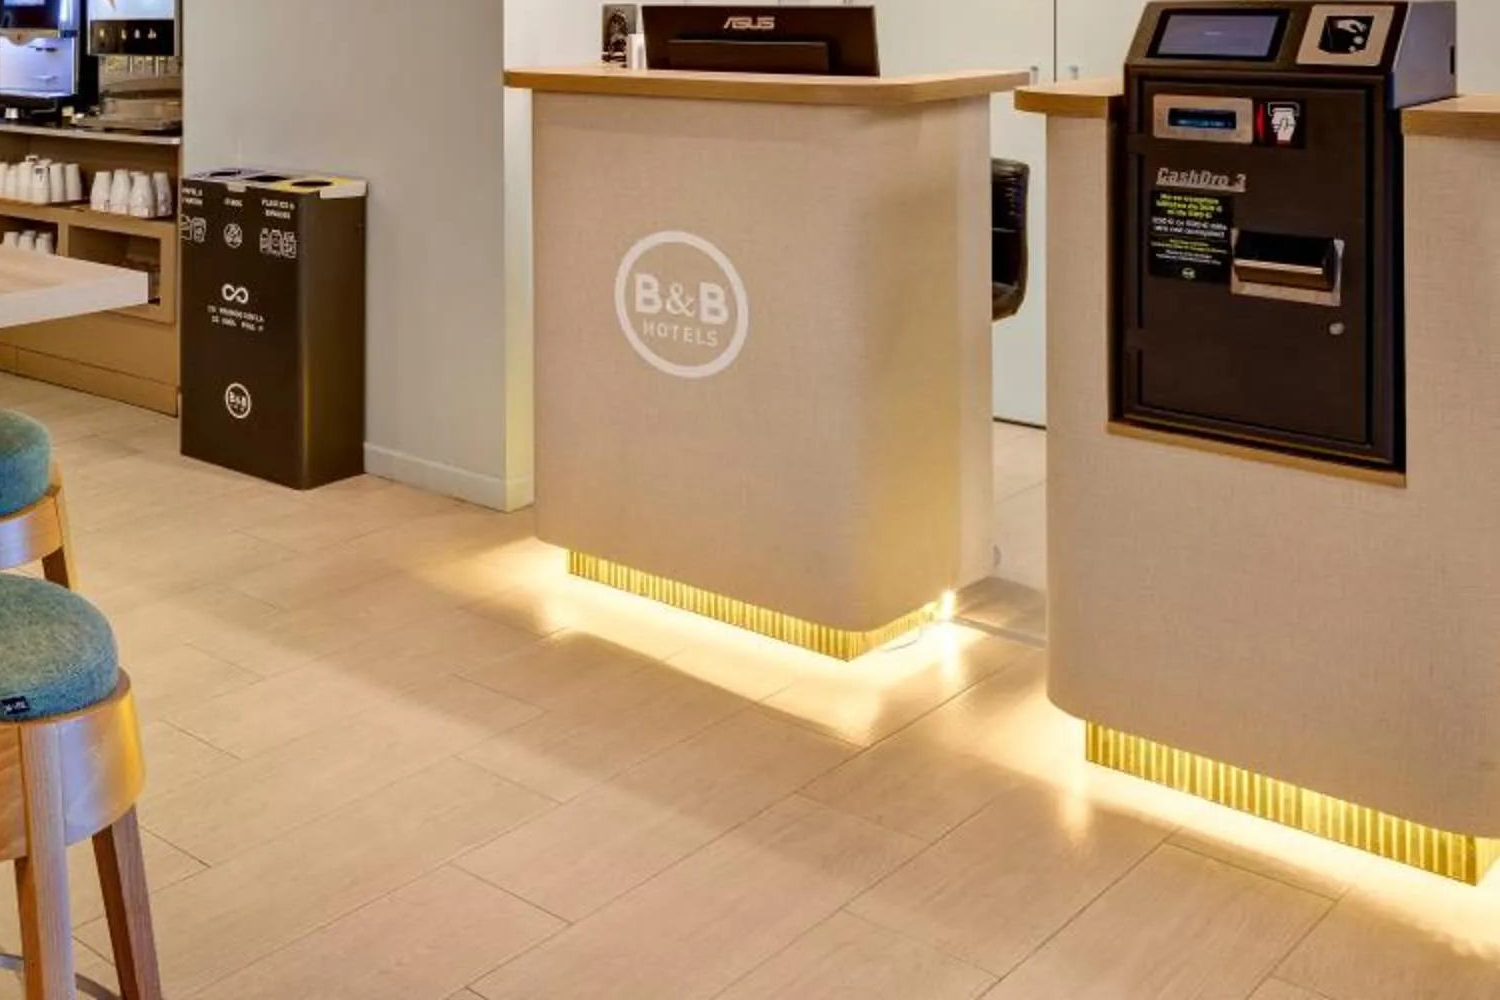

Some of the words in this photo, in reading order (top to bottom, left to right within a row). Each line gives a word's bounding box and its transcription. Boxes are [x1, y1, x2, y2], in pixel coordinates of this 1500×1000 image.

[723, 16, 775, 30] ASUS
[1156, 167, 1229, 187] CashDro
[634, 272, 729, 325] B&B
[643, 318, 719, 348] HOTELS
